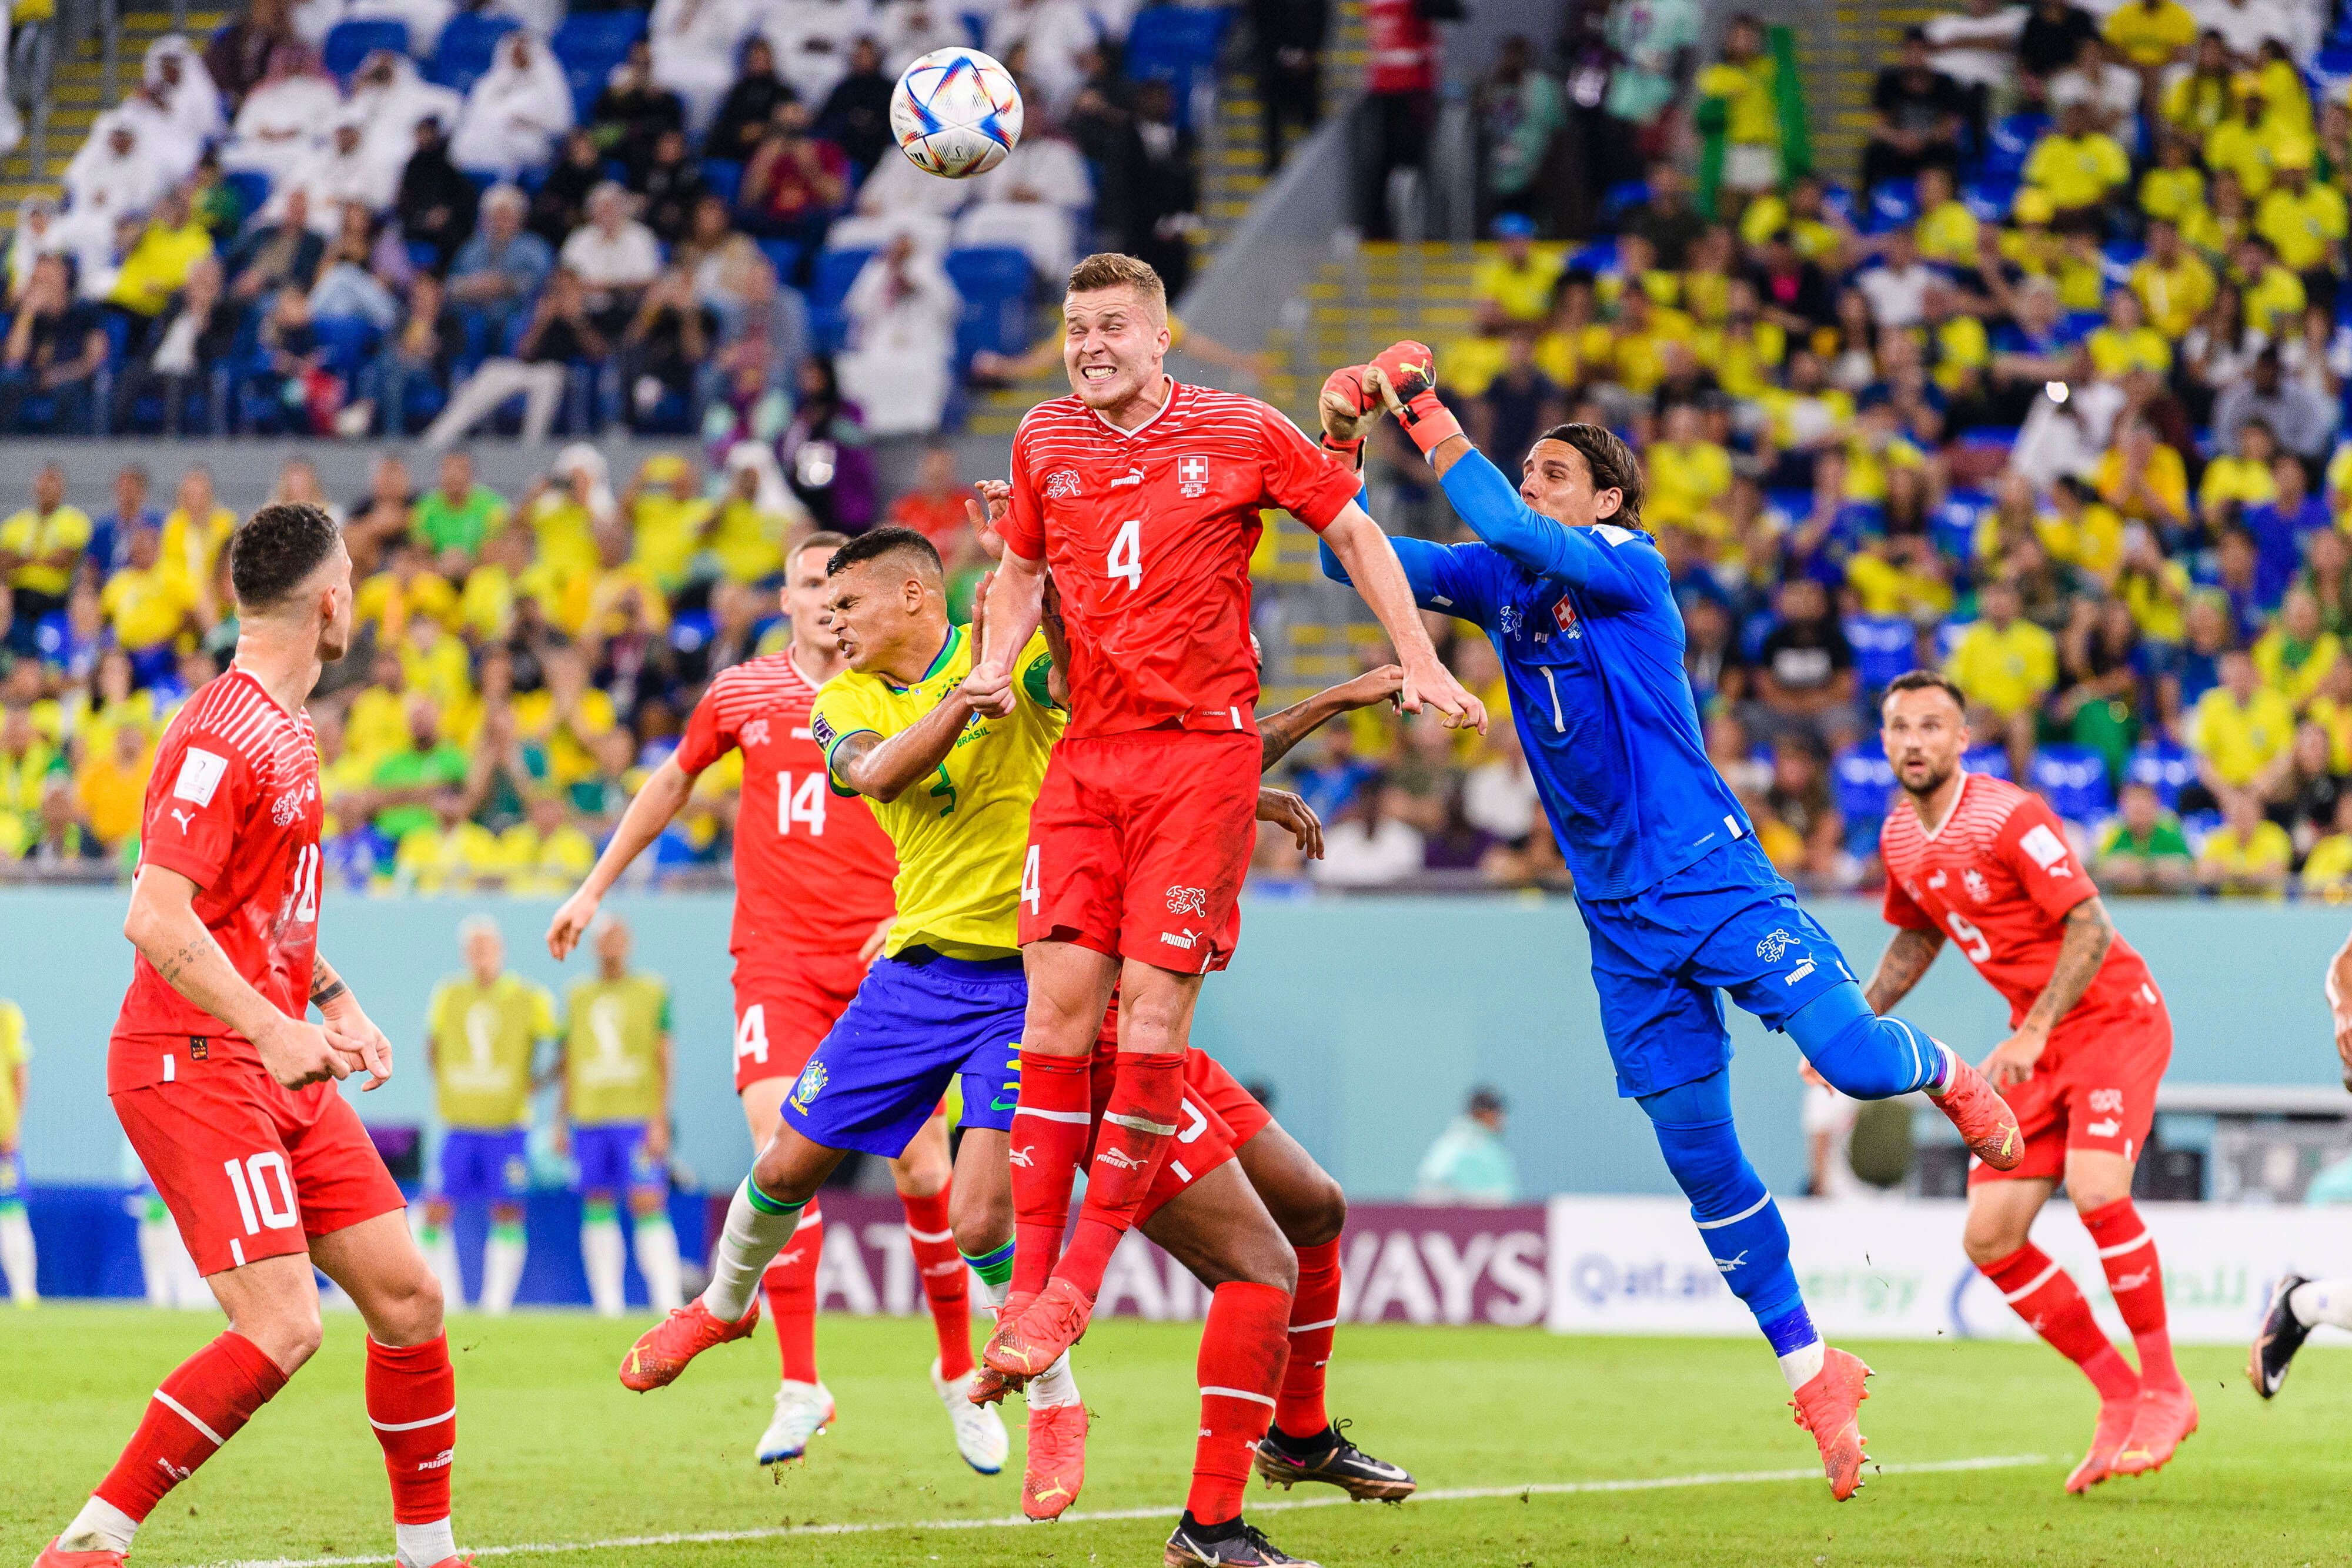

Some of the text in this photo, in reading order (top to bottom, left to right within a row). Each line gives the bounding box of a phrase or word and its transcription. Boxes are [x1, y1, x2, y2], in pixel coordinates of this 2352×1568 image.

[1111, 474, 1140, 489] PUMA
[1107, 520, 1143, 590] 4
[1534, 632, 1548, 643] PU
[1539, 666, 1566, 733] 1
[956, 727, 991, 748] BRASIL
[777, 771, 826, 836] 14
[1021, 844, 1040, 915] 4
[1160, 931, 1192, 950] PUMA
[1784, 962, 1816, 987] PUMA
[1096, 1154, 1130, 1169] PUMA
[224, 1151, 298, 1236] 10
